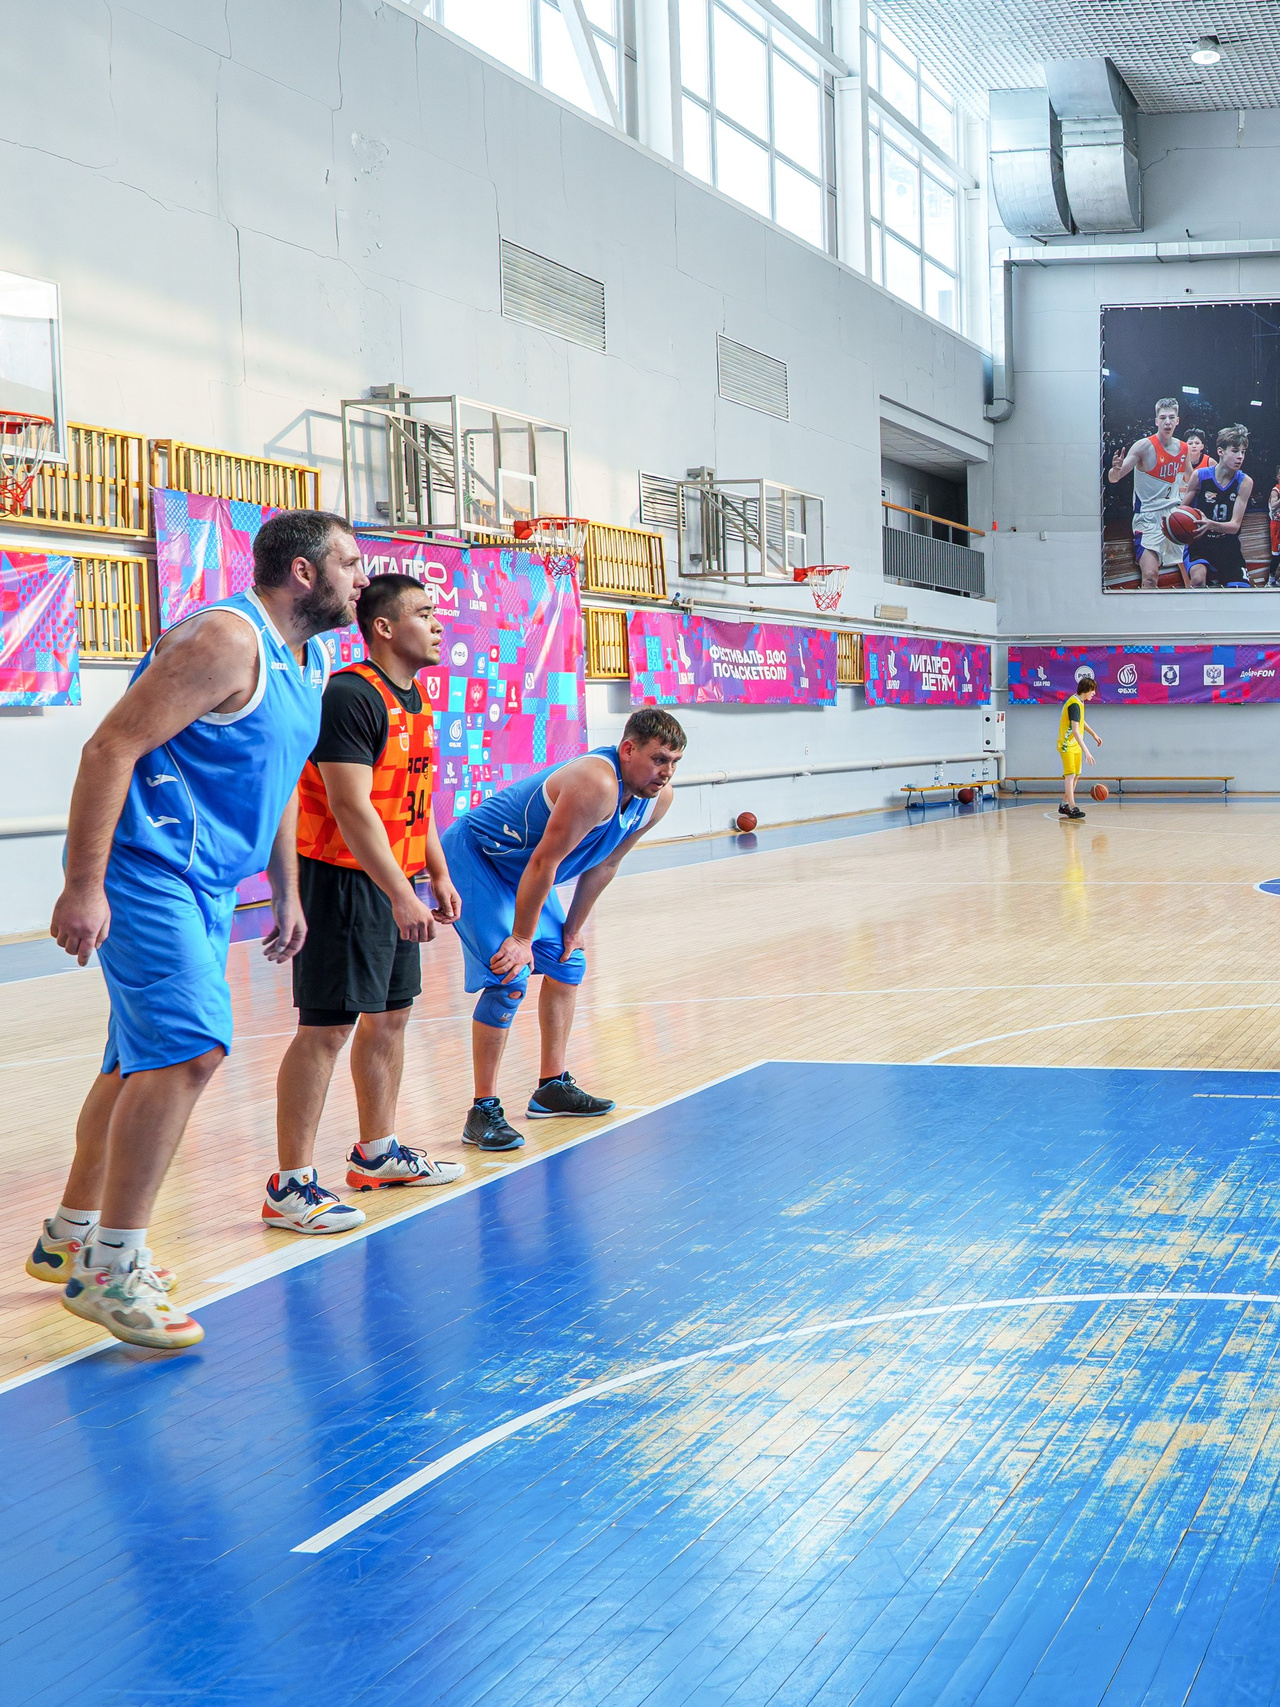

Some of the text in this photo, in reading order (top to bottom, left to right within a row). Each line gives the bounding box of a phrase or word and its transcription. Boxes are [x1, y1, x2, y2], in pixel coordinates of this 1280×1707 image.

[1160, 462, 1182, 478] ЦСК
[1165, 487, 1172, 499] 2
[766, 650, 787, 665] ДФО
[921, 672, 956, 692] ДЕТЯМ
[406, 789, 425, 827] 34
